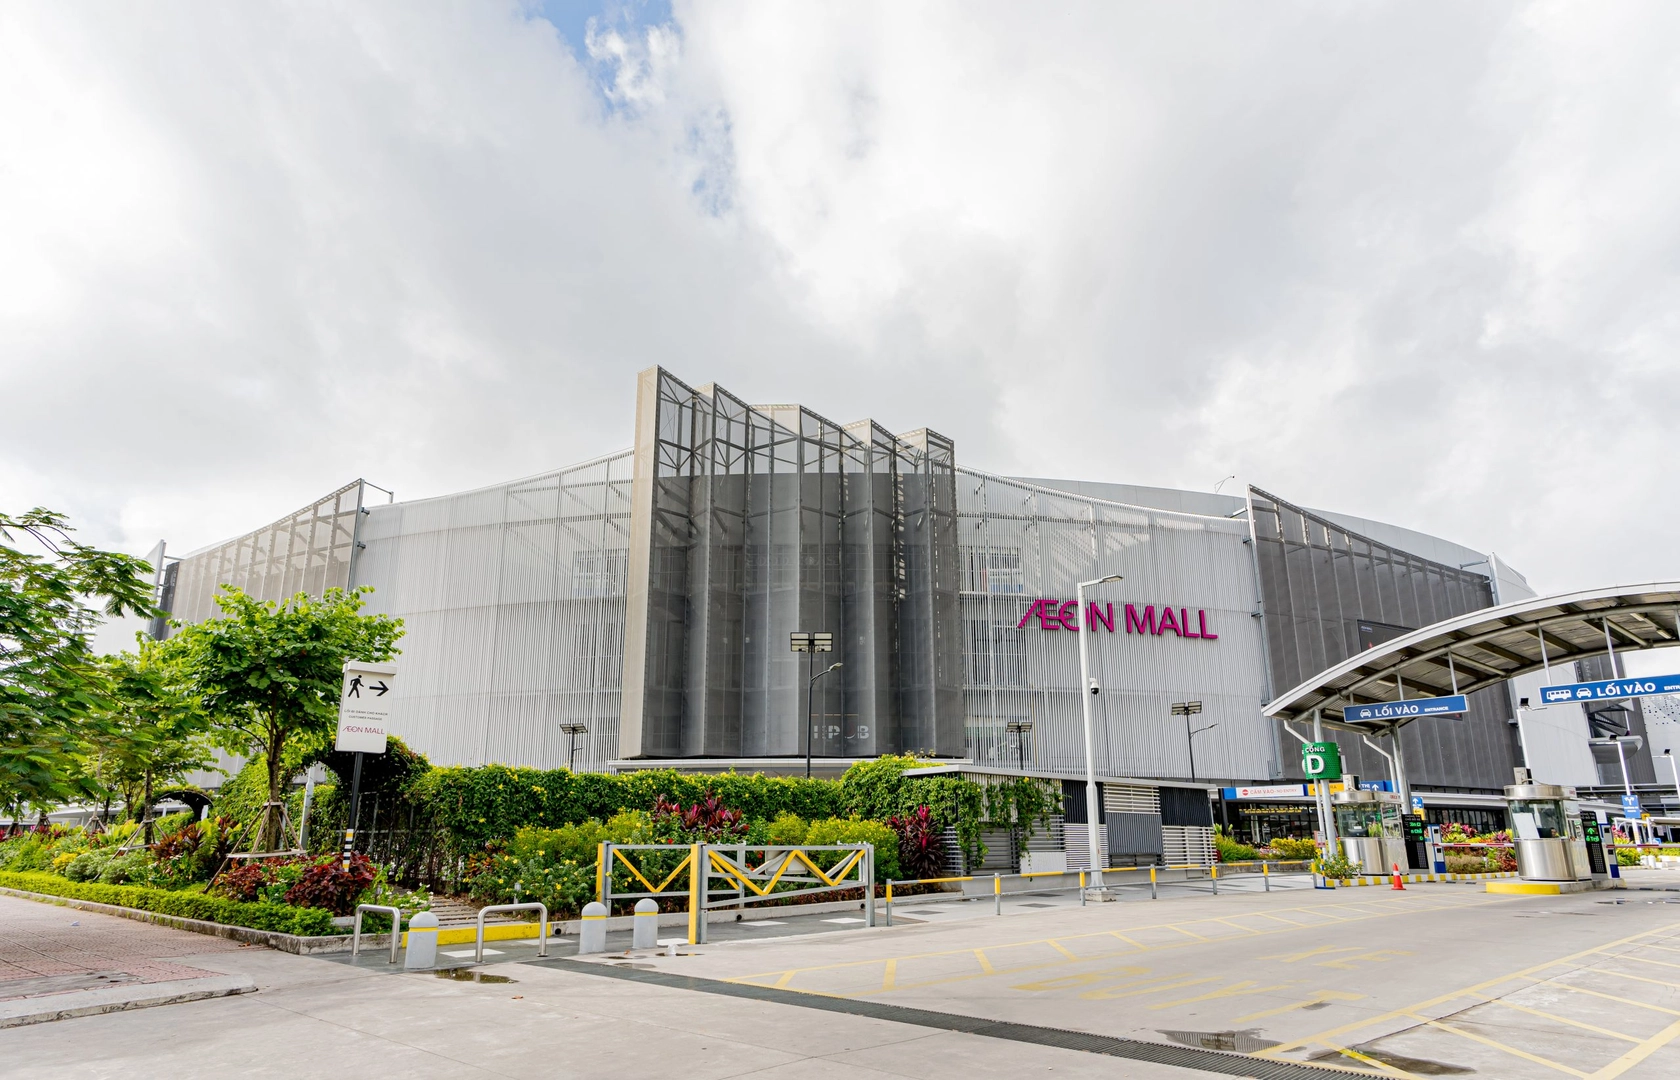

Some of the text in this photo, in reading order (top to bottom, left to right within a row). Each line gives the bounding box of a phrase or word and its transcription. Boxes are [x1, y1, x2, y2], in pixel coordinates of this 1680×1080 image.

[1125, 604, 1218, 639] MALL
[1597, 683, 1620, 696] LỐI
[1624, 682, 1656, 694] VÀO
[1375, 705, 1392, 717] LỐI
[1395, 704, 1418, 714] VÀO
[1306, 755, 1324, 774] D
